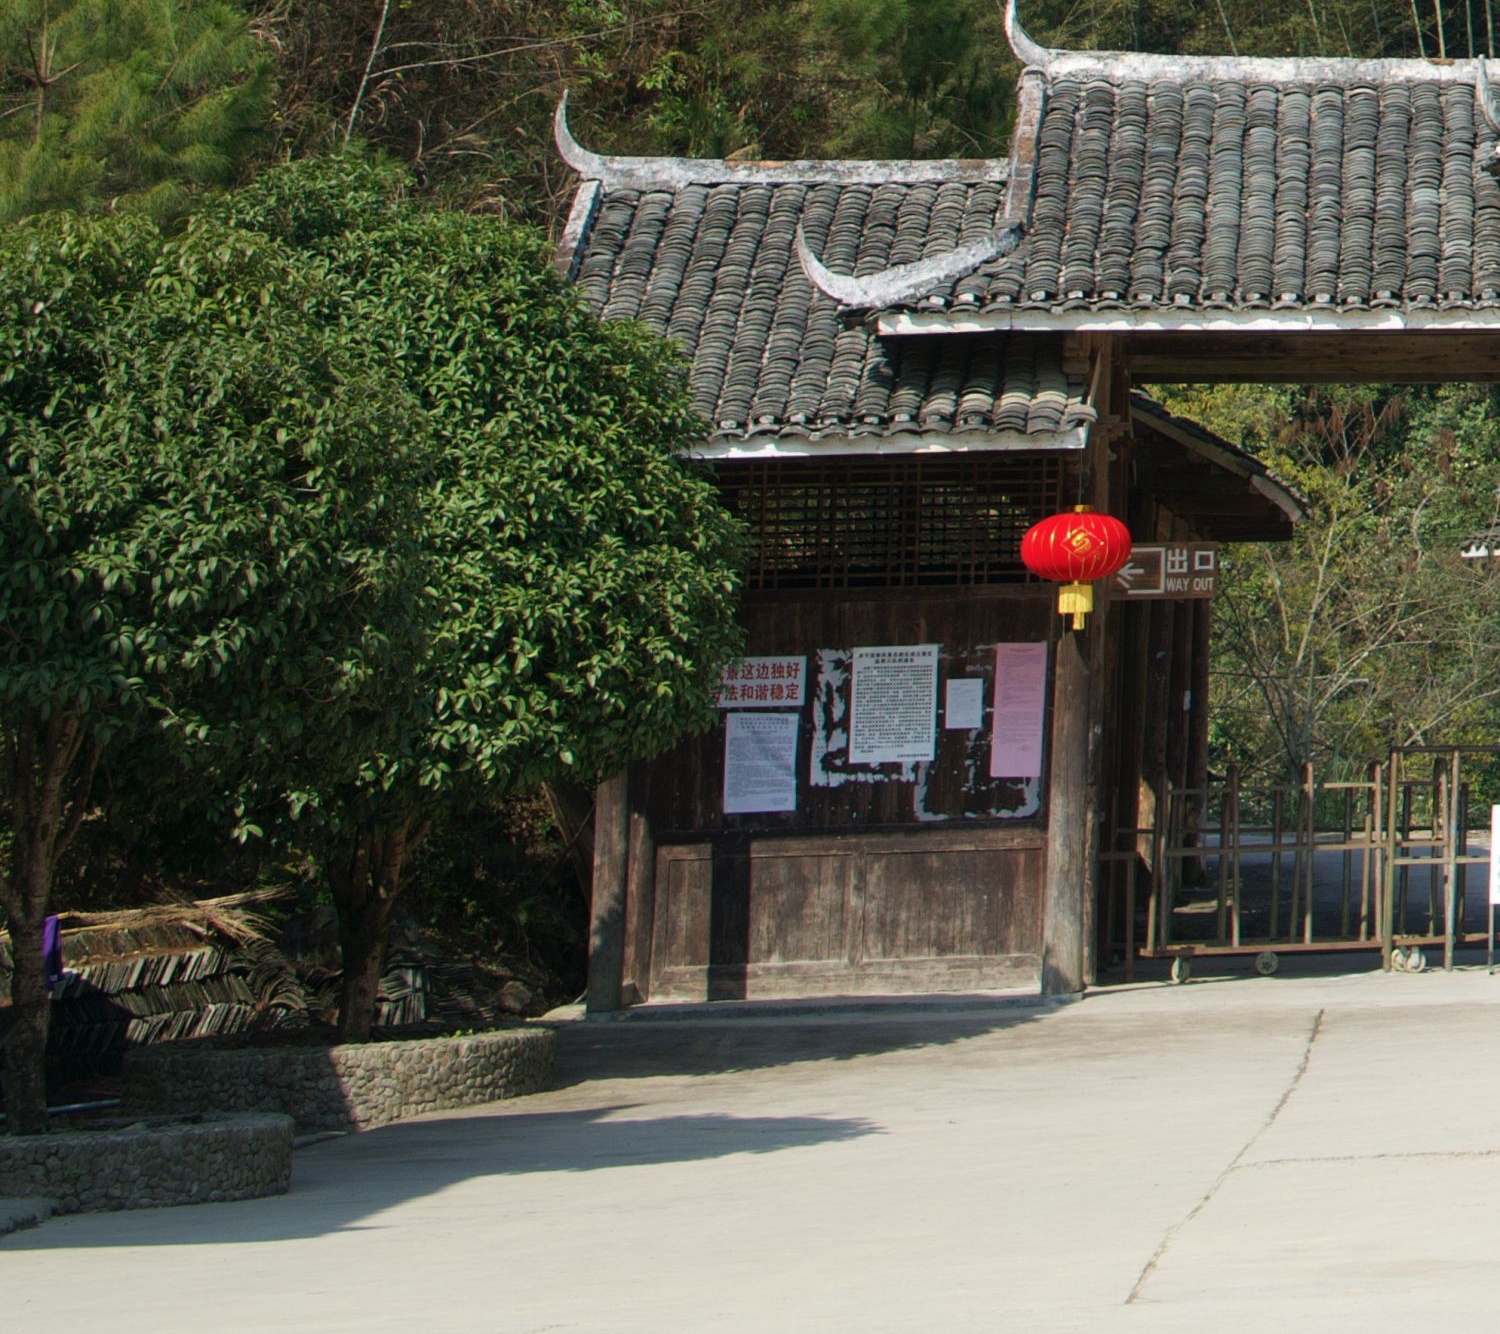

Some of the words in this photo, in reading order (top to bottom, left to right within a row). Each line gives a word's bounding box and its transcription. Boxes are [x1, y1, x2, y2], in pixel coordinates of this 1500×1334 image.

[1167, 548, 1214, 572] 出口
[1166, 578, 1189, 592] WAY
[1193, 577, 1214, 591] OUT
[719, 661, 800, 681] 景这边独好
